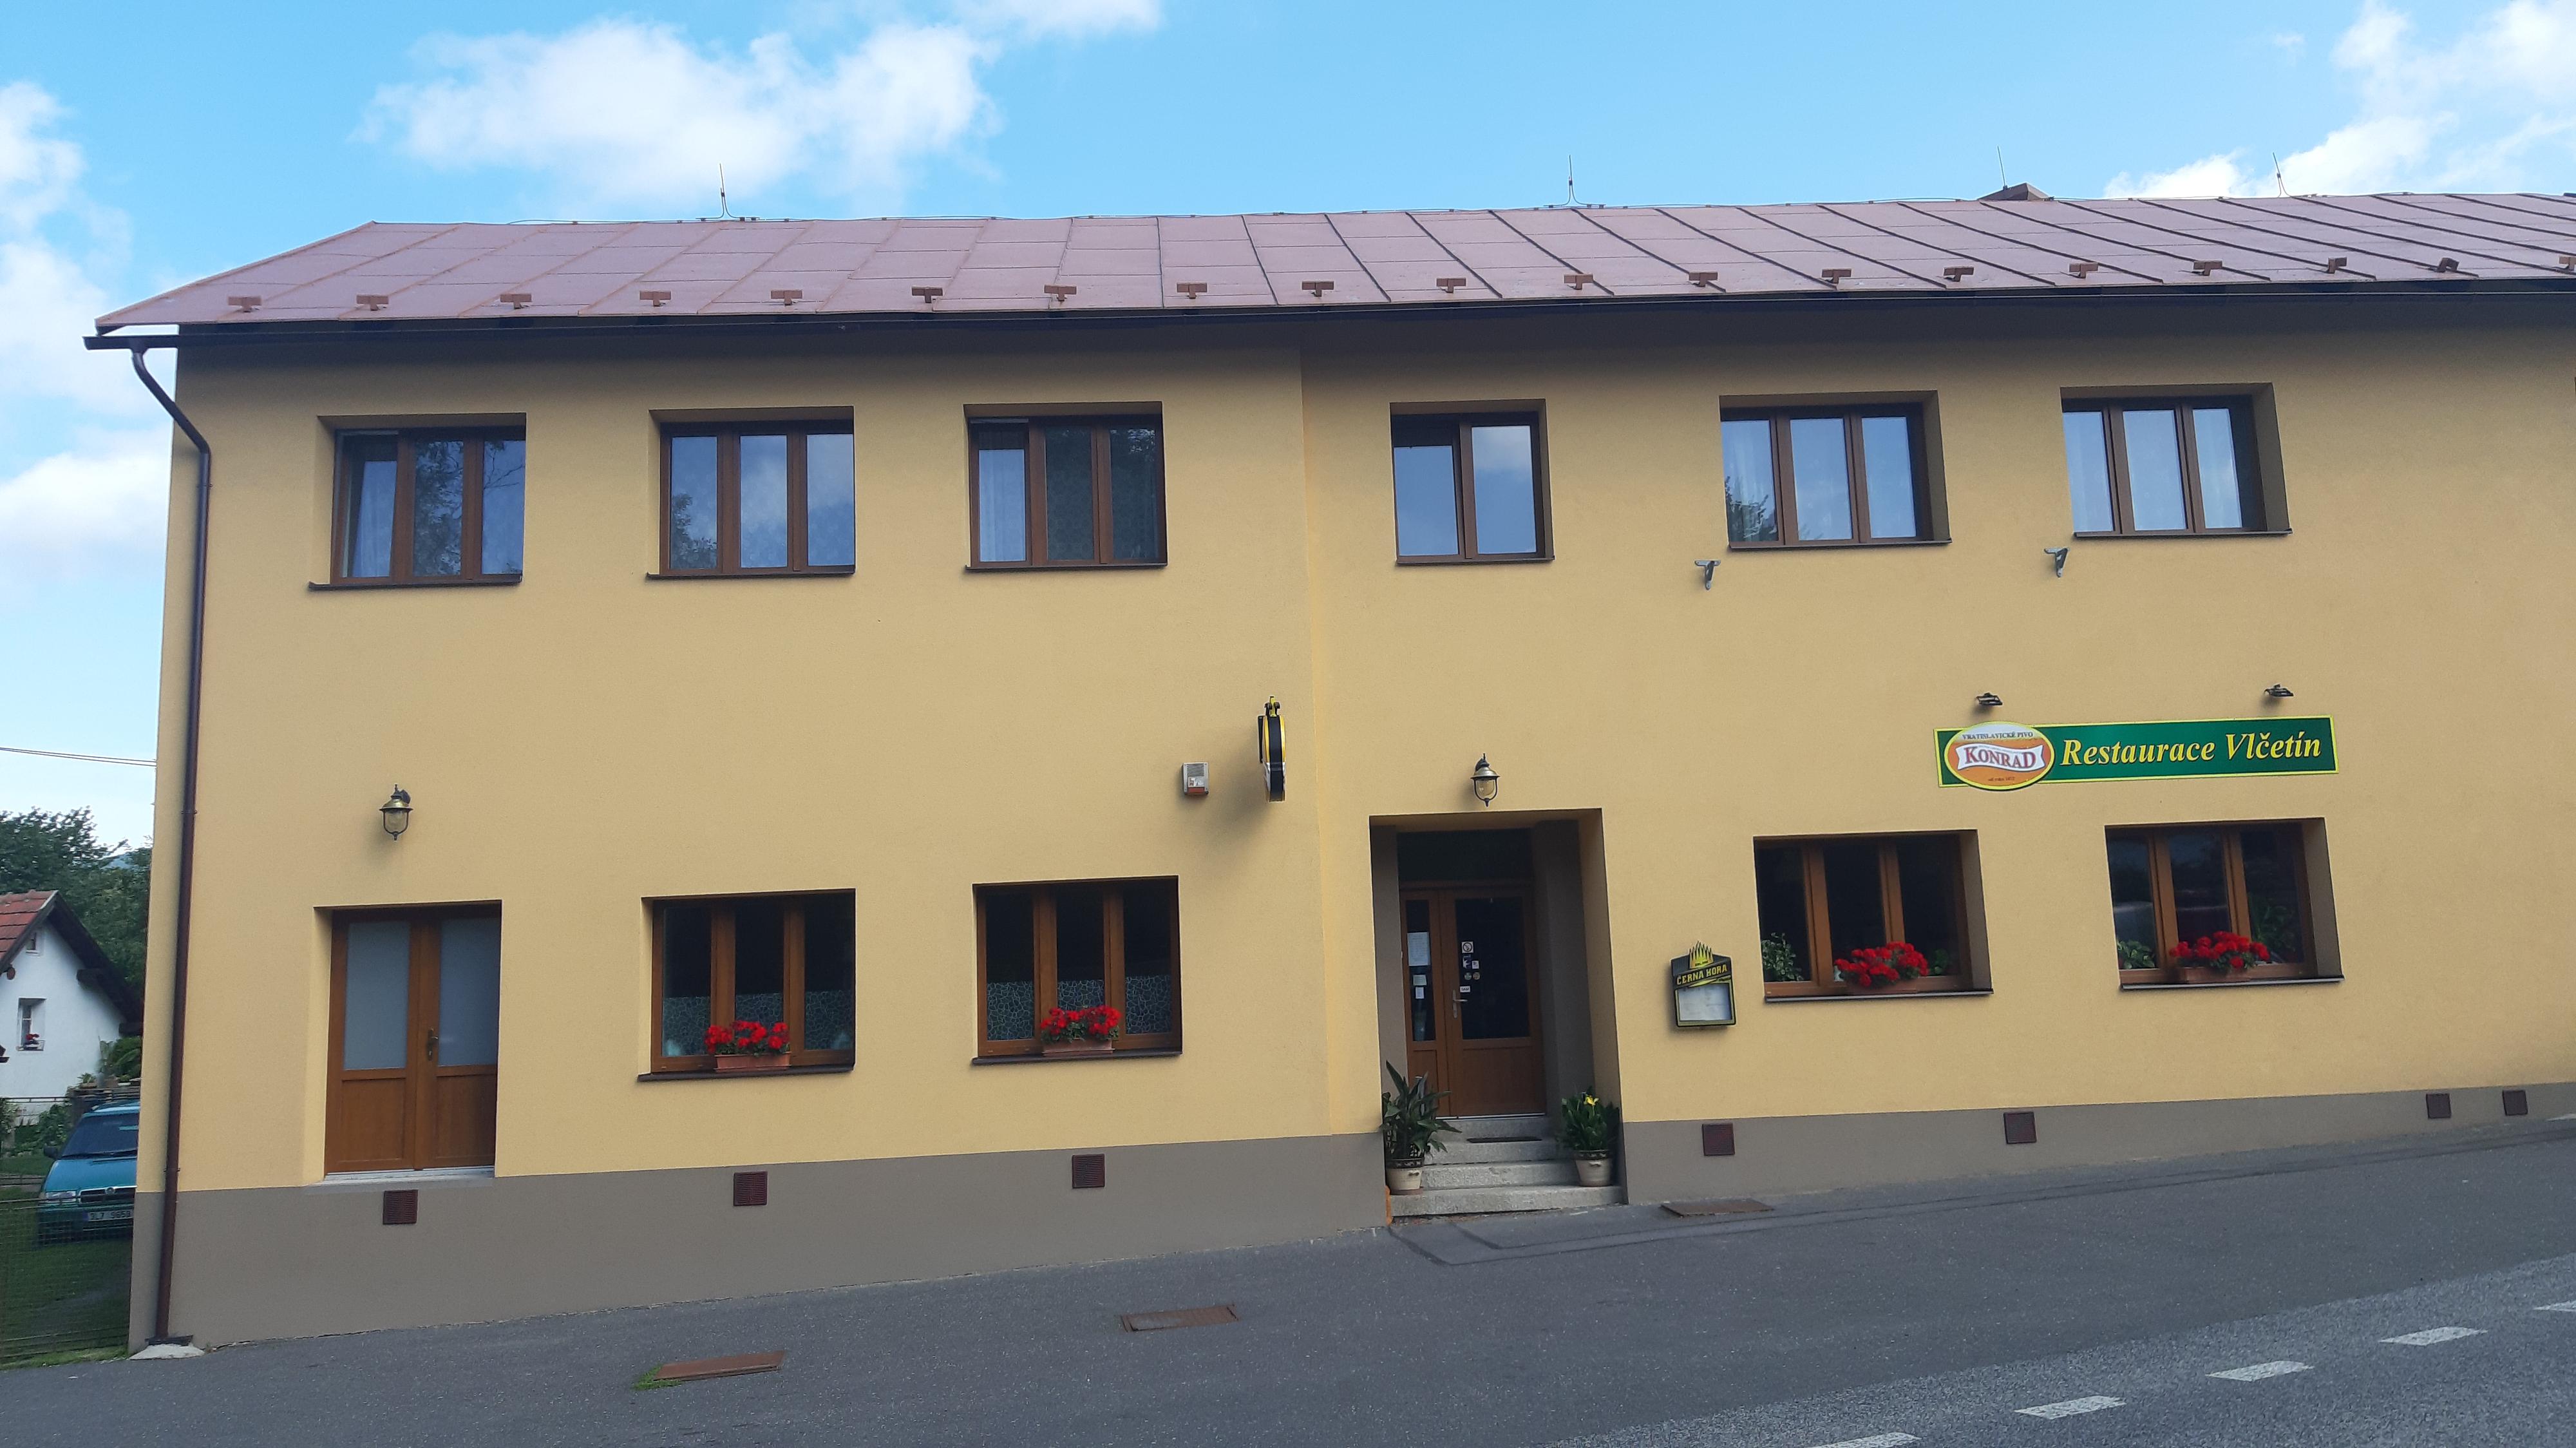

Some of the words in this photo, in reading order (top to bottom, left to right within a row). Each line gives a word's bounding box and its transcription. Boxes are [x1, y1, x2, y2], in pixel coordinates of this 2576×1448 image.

[1965, 746, 2036, 768] KONRAD
[2060, 739, 2215, 766] Restaurace
[2226, 731, 2322, 760] Vlčetín
[1706, 964, 1728, 978] HORA
